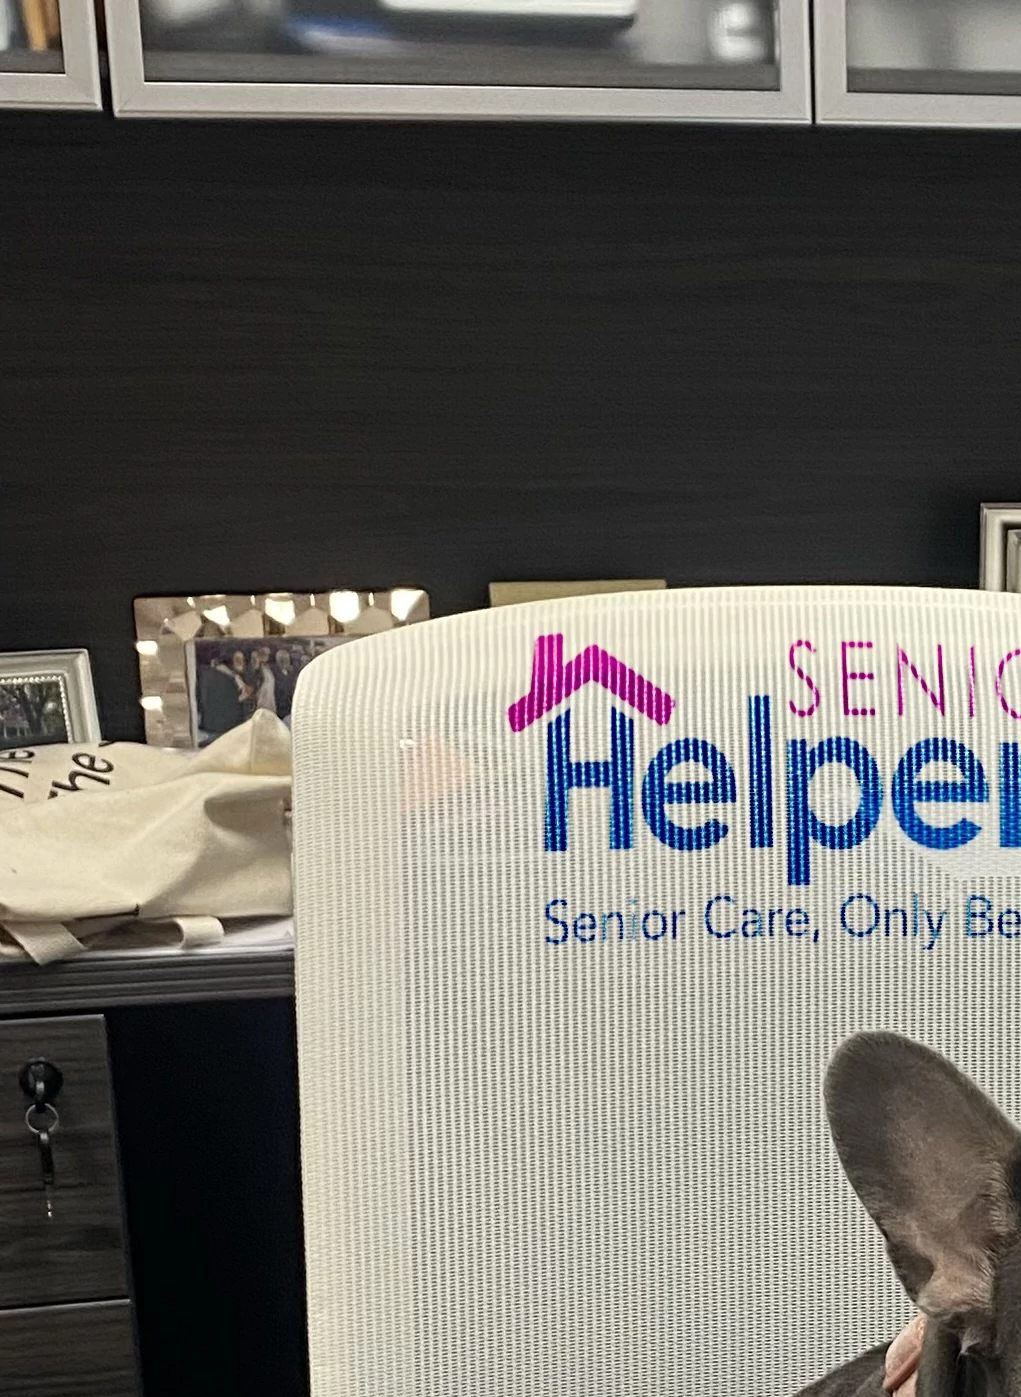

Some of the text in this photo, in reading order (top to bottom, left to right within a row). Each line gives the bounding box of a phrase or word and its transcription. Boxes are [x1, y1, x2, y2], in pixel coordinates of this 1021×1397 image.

[47, 752, 114, 799] he
[544, 899, 687, 945] Senior
[704, 895, 820, 944] Care,
[839, 893, 948, 951] Only
